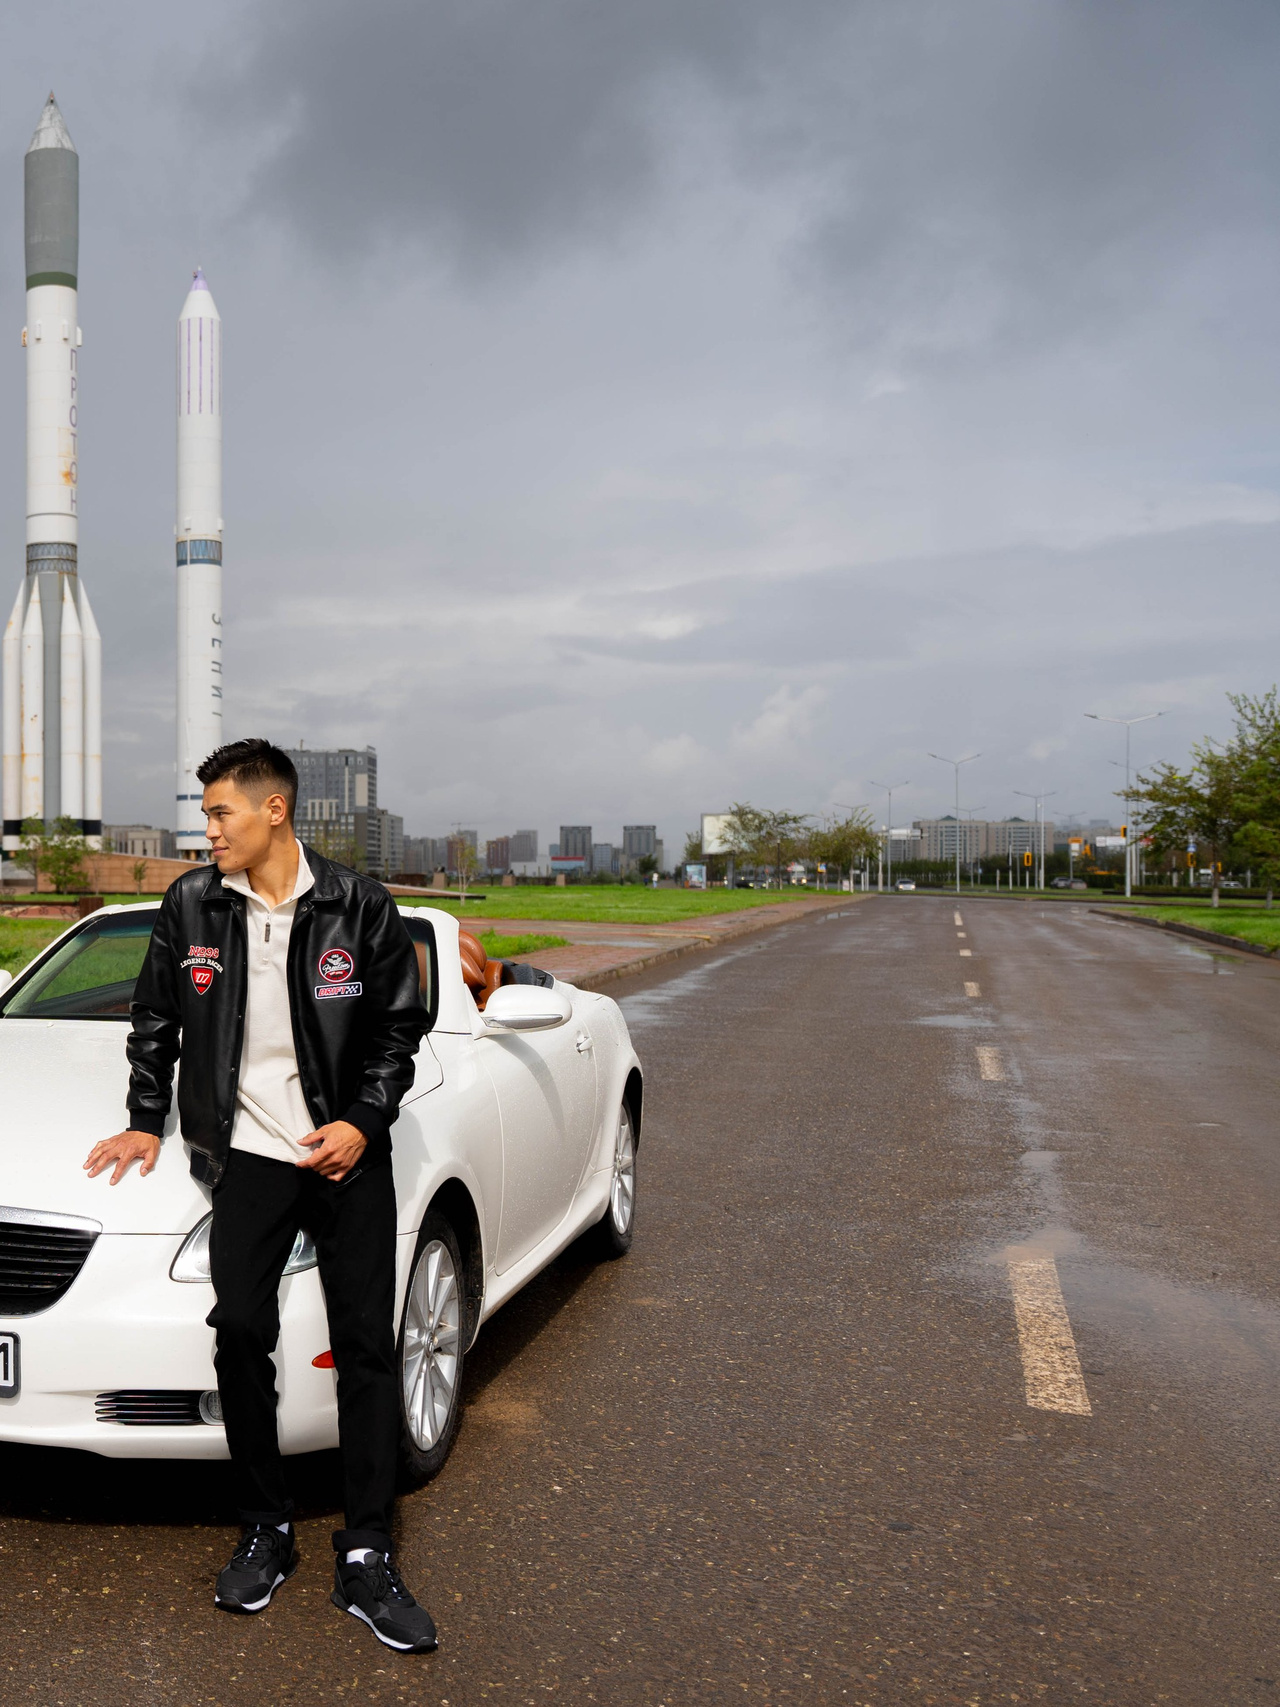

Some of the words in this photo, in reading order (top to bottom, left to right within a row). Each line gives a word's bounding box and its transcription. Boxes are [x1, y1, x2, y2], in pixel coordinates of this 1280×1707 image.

[180, 957, 206, 969] LEGEND
[195, 972, 210, 984] 07
[318, 986, 347, 997] DRIFT
